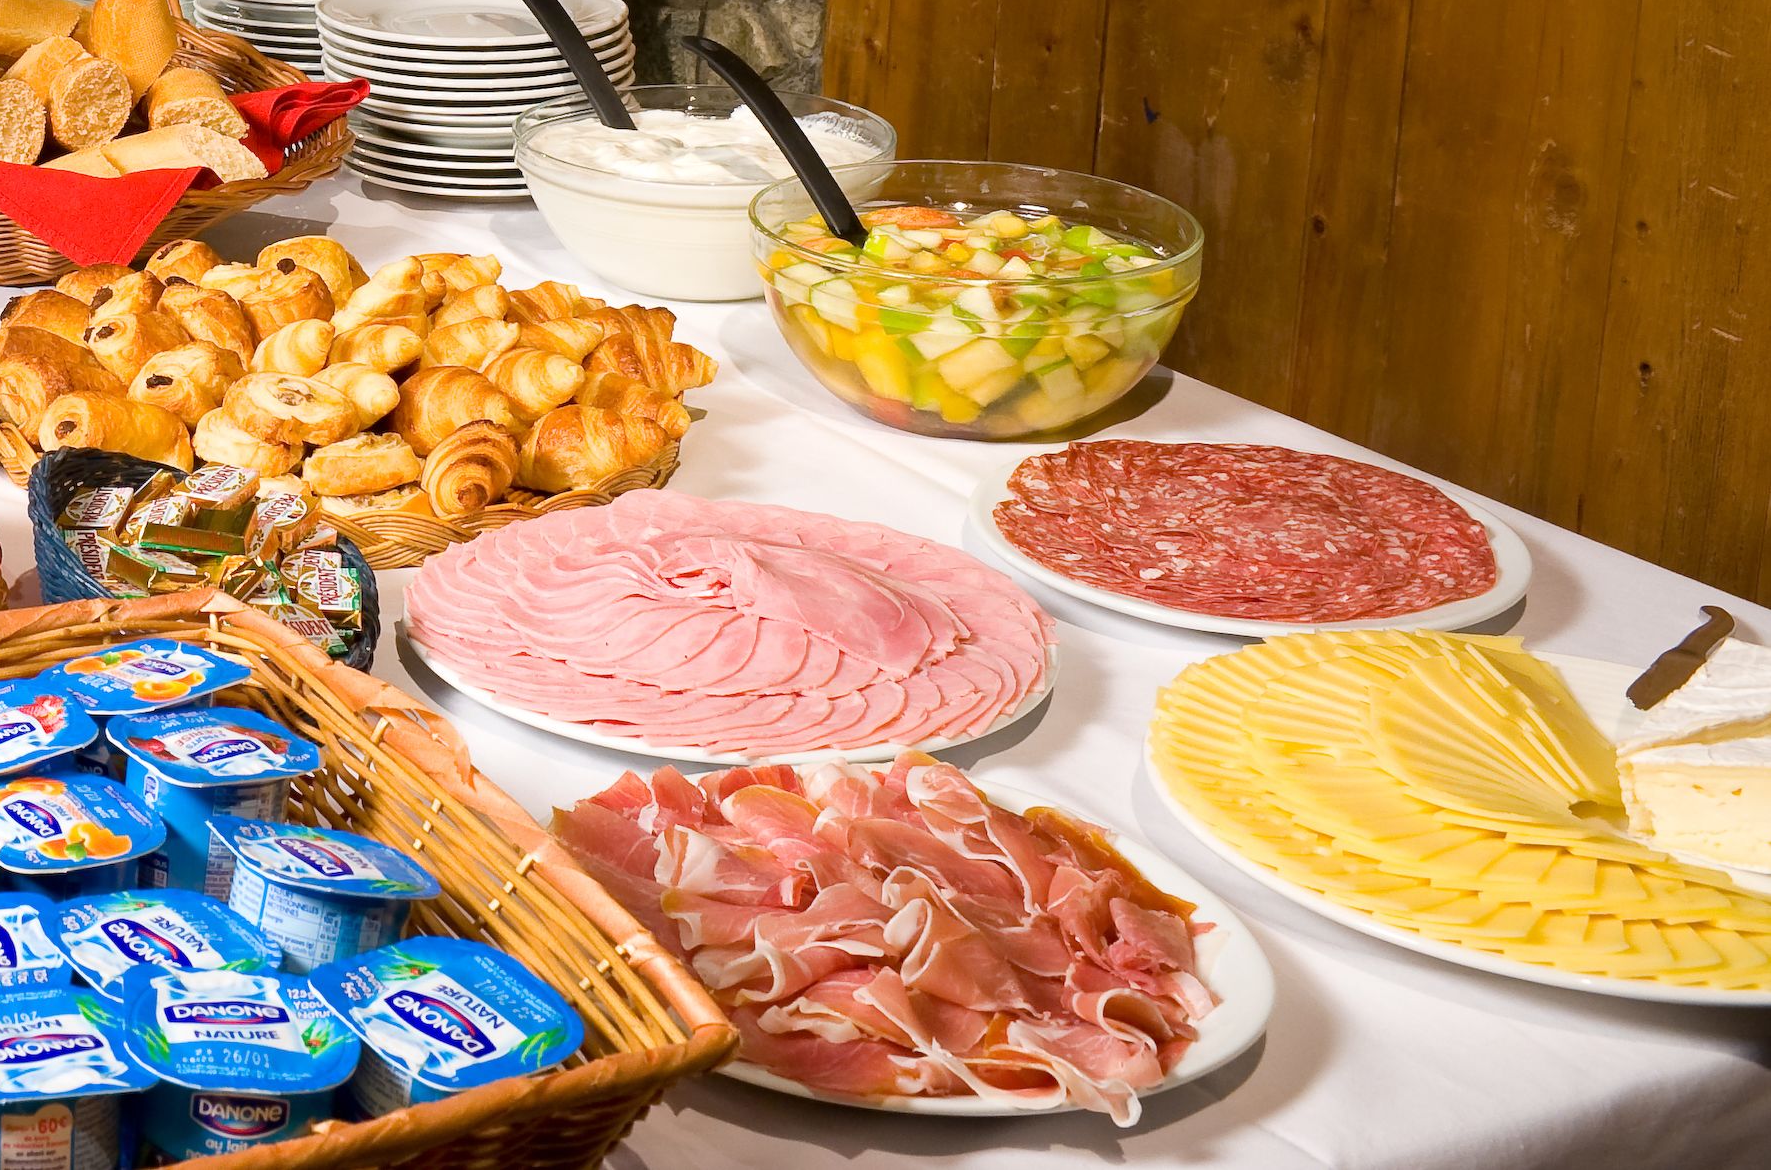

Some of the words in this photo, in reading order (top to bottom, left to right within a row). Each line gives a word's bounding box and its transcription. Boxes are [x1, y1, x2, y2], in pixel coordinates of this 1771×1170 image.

[319, 568, 340, 607] PRÉSIDENT
[108, 922, 183, 968] ANONE
[151, 915, 209, 953] NATURE
[432, 983, 506, 1030] NATURE
[194, 1029, 281, 1041] NATURE
[223, 1049, 270, 1069] 26/01
